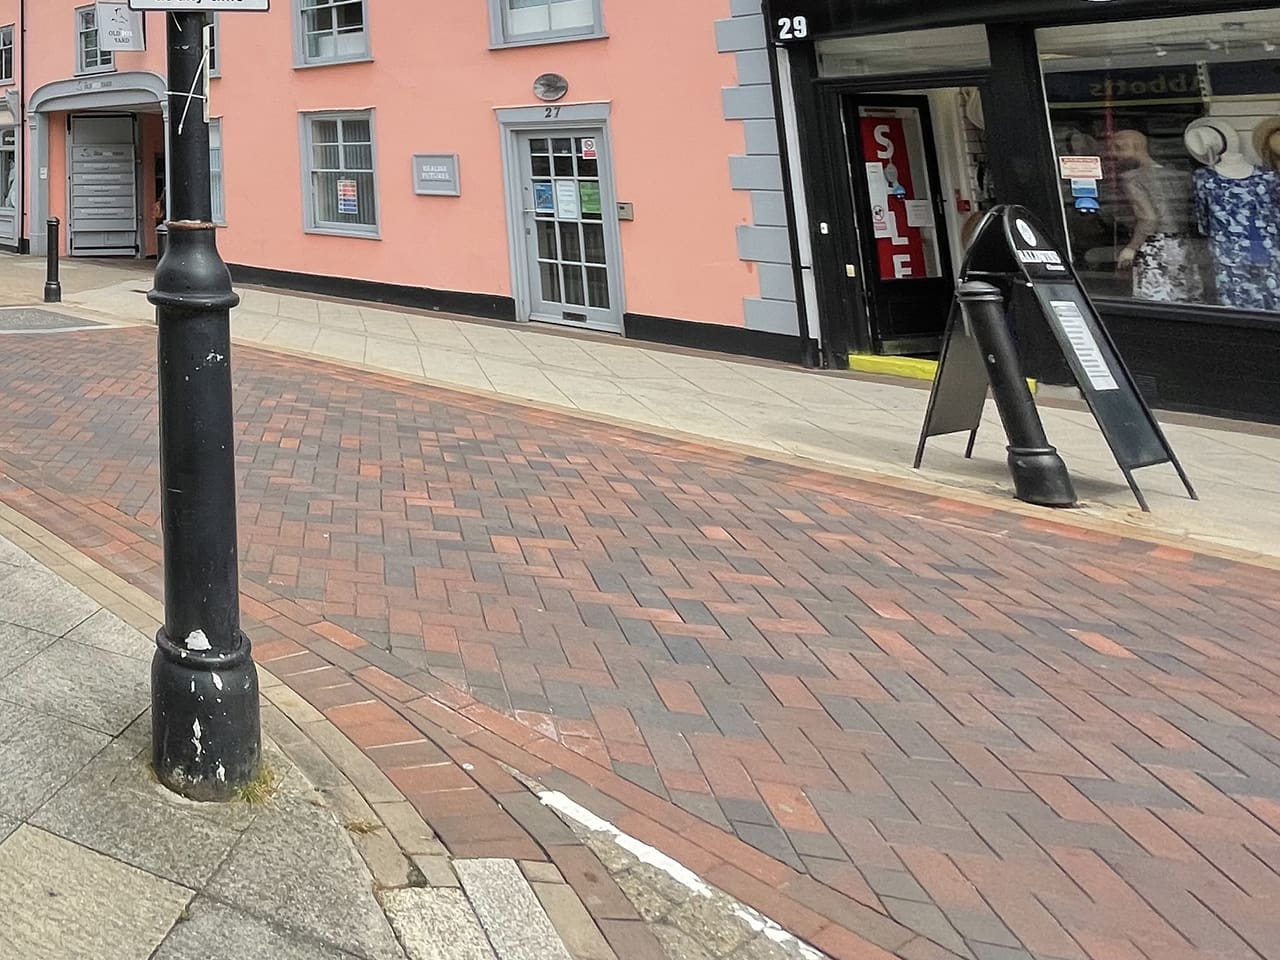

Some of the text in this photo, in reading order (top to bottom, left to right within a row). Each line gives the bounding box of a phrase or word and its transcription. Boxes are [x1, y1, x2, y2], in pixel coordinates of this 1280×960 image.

[778, 16, 807, 39] 29
[545, 107, 561, 118] 27
[873, 124, 913, 279] SLE
